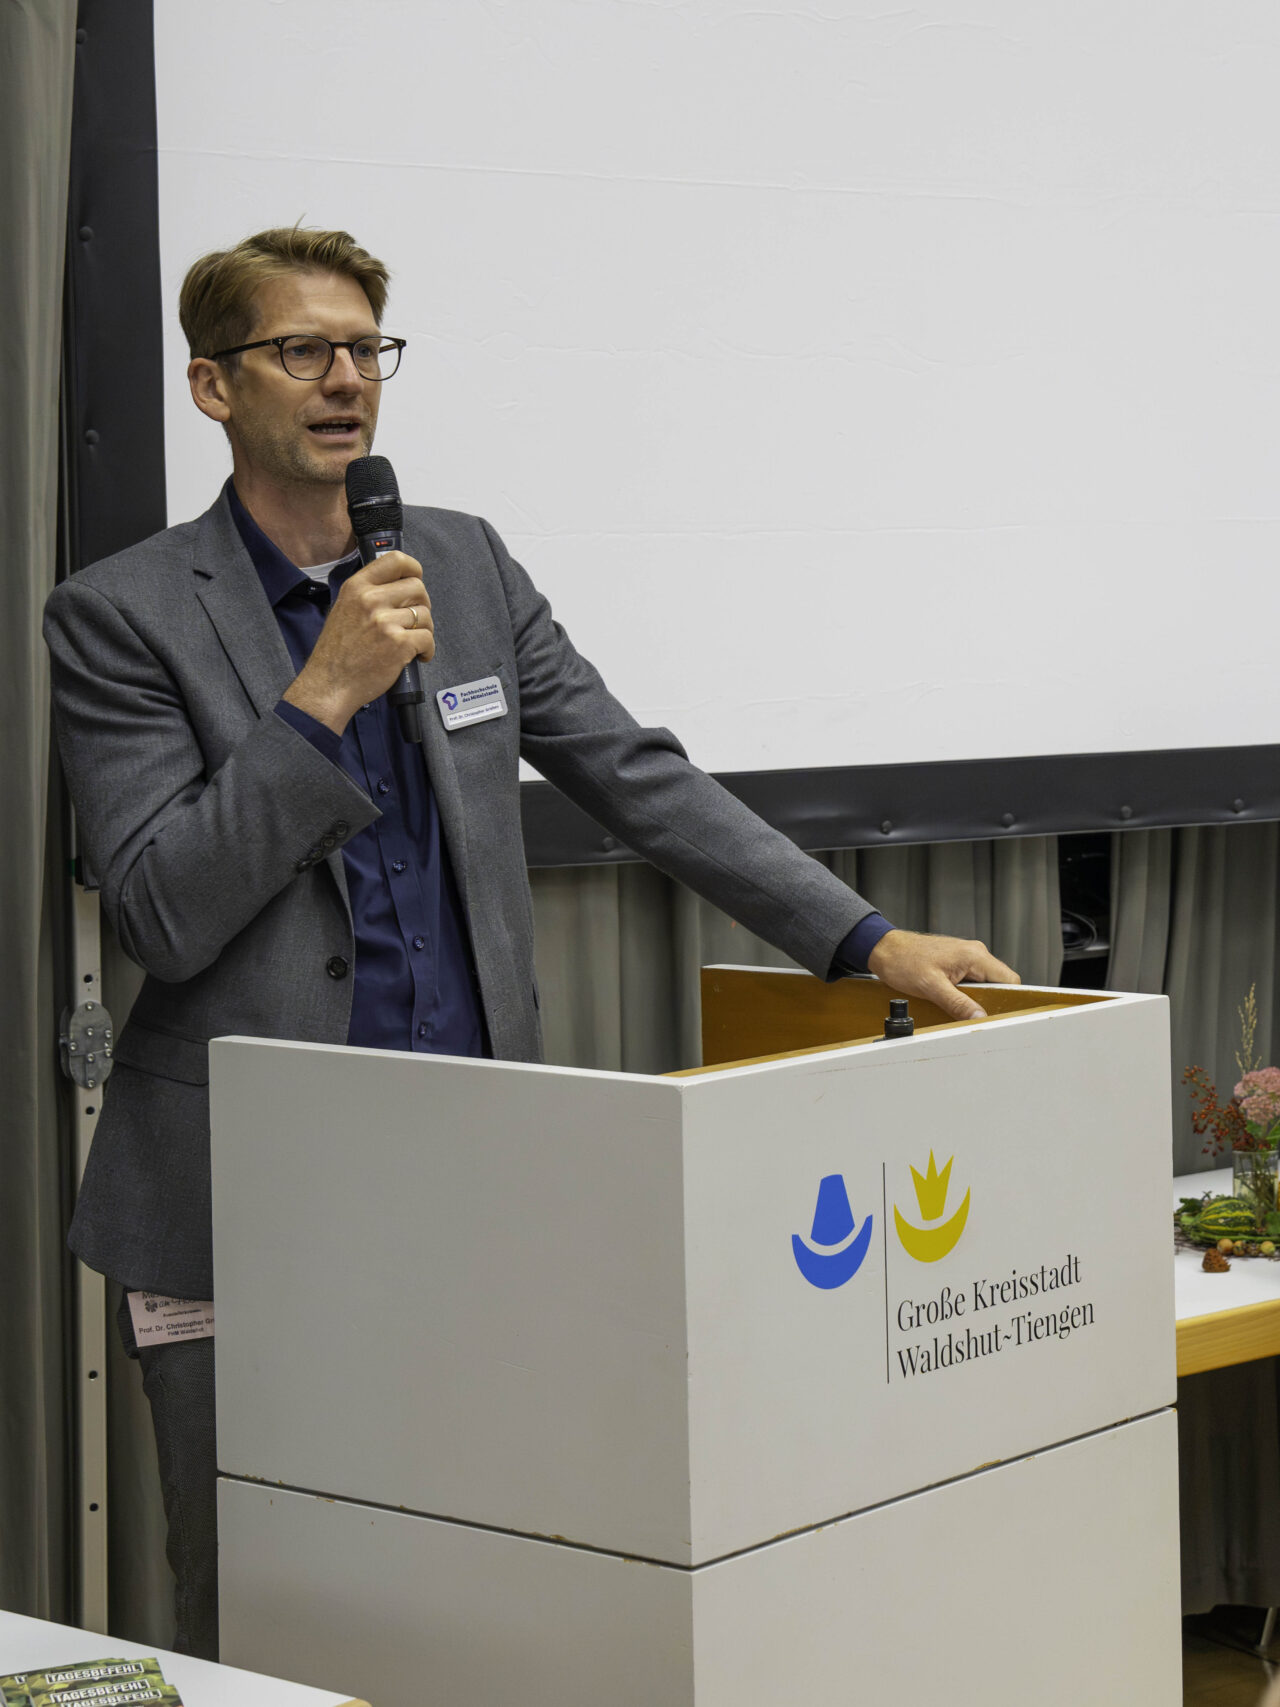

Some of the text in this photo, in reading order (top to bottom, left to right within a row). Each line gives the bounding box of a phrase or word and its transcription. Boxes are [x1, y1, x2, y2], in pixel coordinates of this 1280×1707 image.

[461, 684, 497, 697] Fachhochschule
[471, 690, 499, 700] Mittelstands
[896, 1254, 1082, 1332] Große Kreisstadt
[139, 1326, 154, 1334] Prof.
[166, 1319, 204, 1330] Christopher
